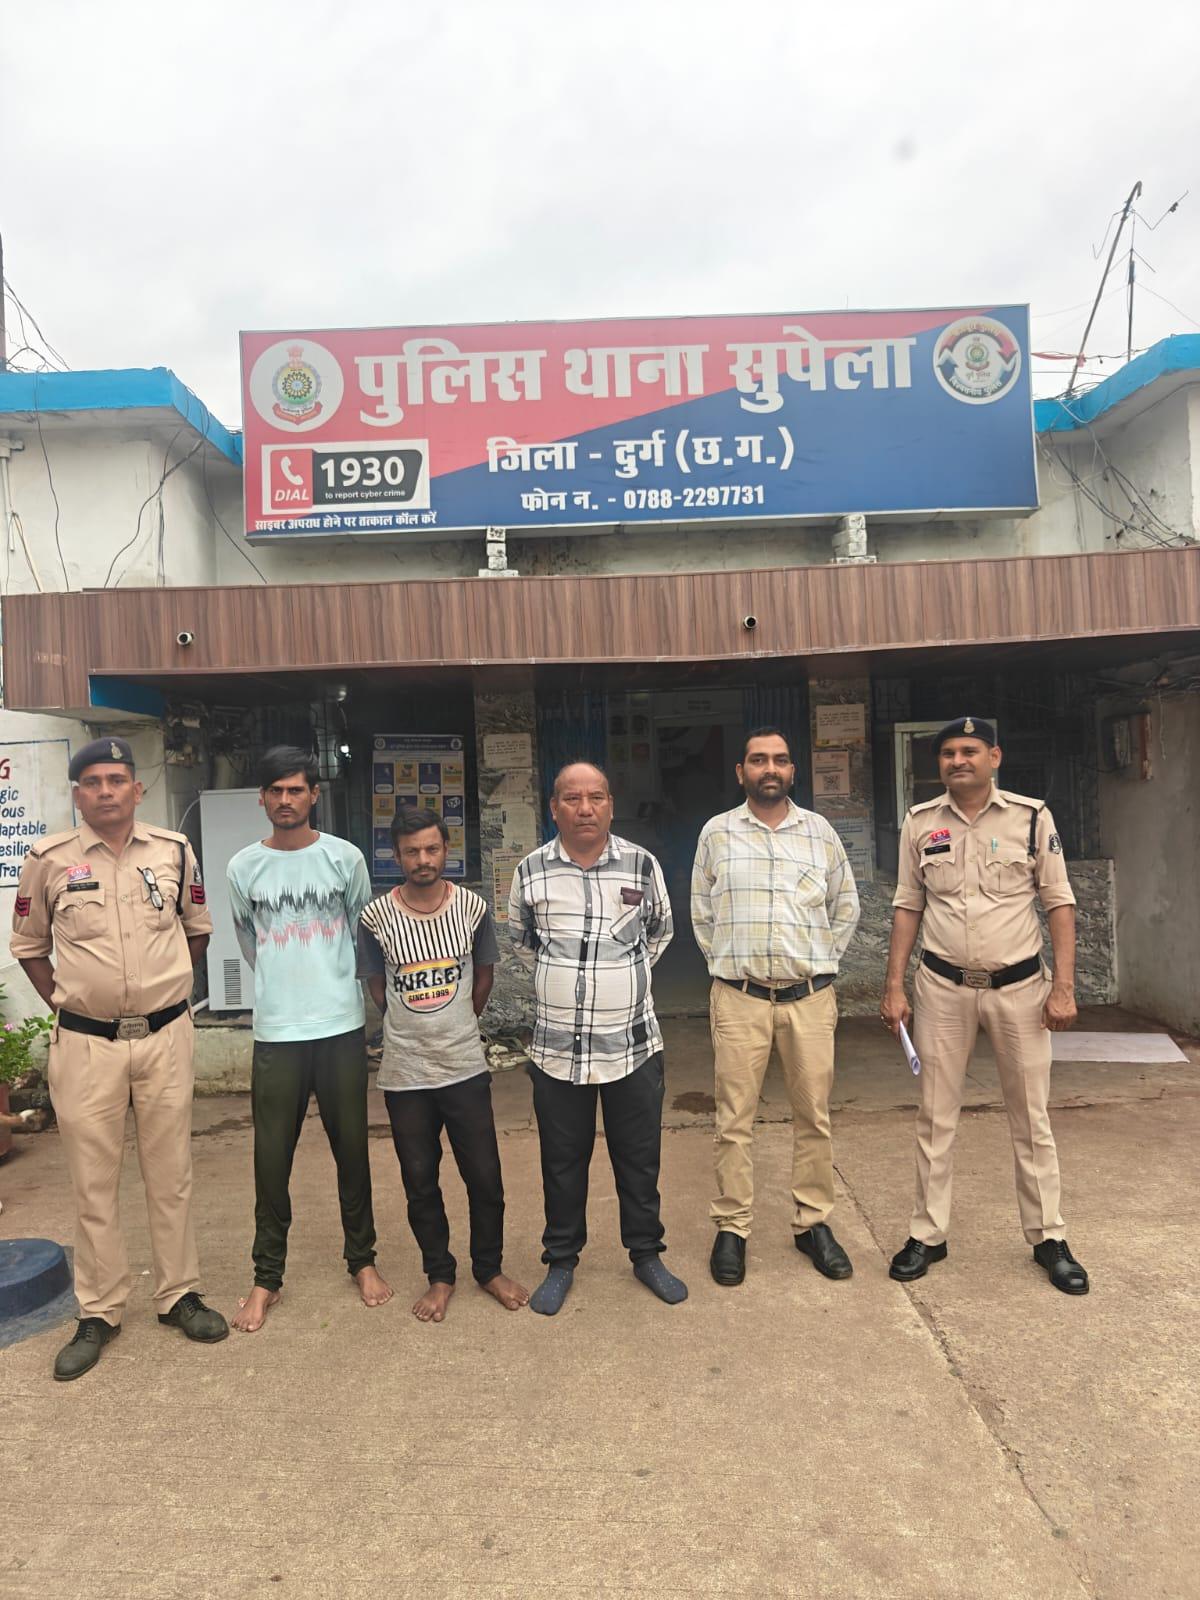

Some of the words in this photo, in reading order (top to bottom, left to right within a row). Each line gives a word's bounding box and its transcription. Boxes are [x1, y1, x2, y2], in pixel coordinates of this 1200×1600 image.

[354, 338, 547, 427] पुलिस
[564, 344, 710, 399] थाना
[726, 325, 917, 414] सुपेला
[486, 436, 579, 473] जिला
[612, 429, 666, 478] दुर्ग
[675, 426, 795, 474] (छ.ग.)
[320, 456, 405, 488] 1930
[274, 489, 310, 502] DIAL
[335, 490, 359, 500] report
[360, 489, 382, 499] cyber
[383, 489, 406, 497] crime
[521, 487, 567, 511] फोन
[573, 491, 599, 510] न.
[624, 485, 764, 509] 0788-2297731
[255, 519, 285, 532] साइबर
[288, 517, 320, 530] अपराध
[323, 515, 341, 528] होने
[344, 516, 357, 527] पर
[359, 514, 393, 527] तत्काल
[395, 512, 418, 525] कॉल
[421, 511, 437, 524] करें
[0, 805, 25, 818] ous
[0, 820, 47, 840] aptable
[0, 841, 33, 856] esilie
[408, 992, 430, 1003] SINCE
